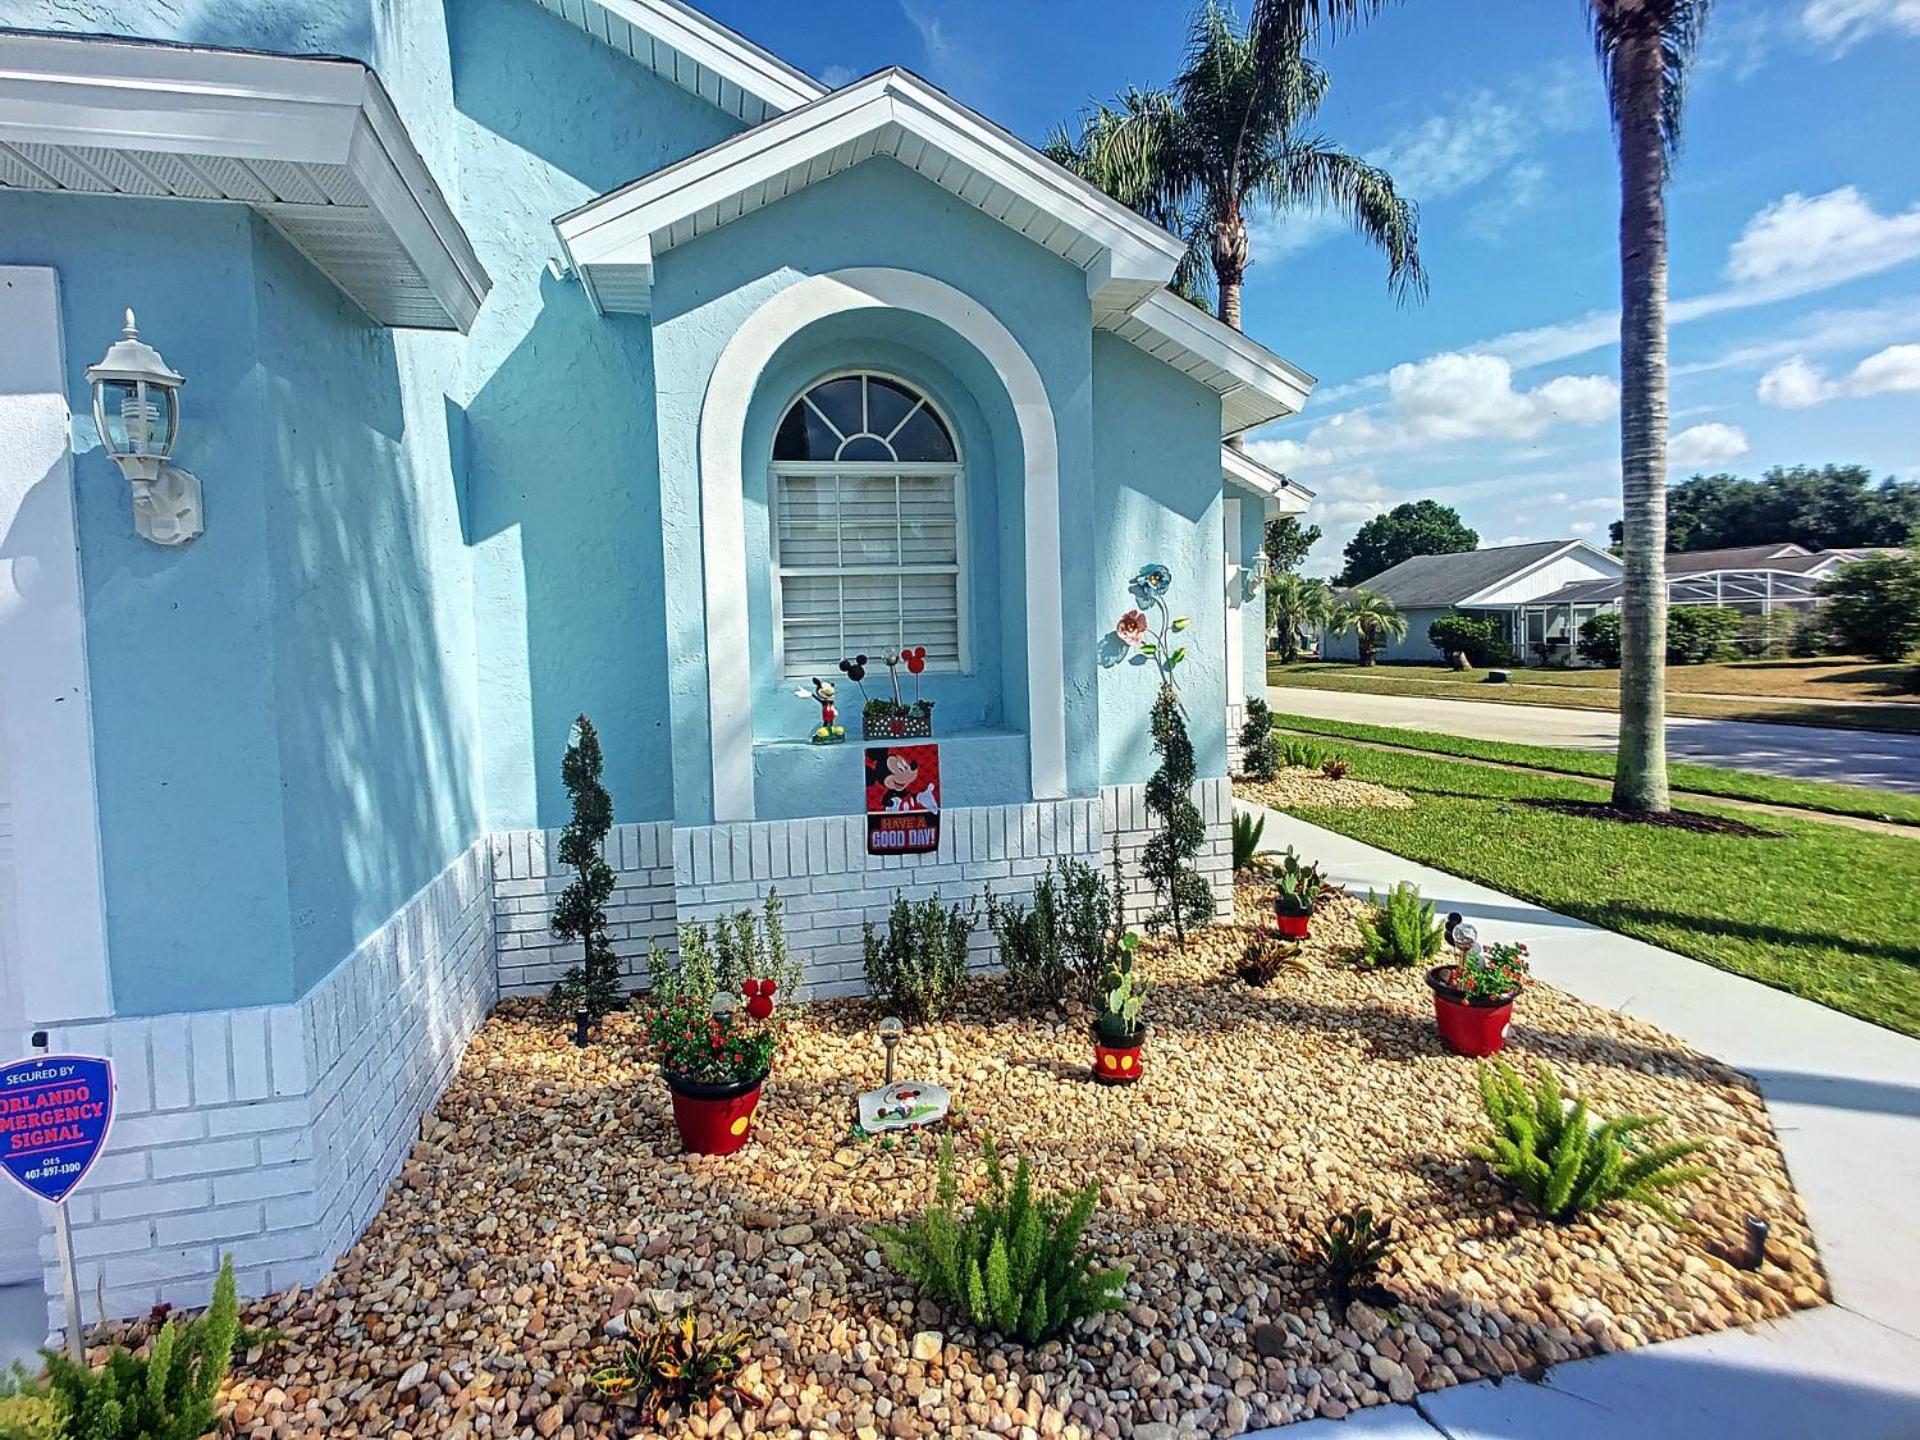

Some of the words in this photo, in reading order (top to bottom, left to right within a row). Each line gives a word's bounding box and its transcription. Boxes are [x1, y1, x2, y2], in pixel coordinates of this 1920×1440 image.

[881, 817, 914, 830] HAVE
[917, 816, 927, 829] A
[872, 830, 905, 847] GOOD
[909, 828, 935, 846] DAY!
[6, 1068, 58, 1085] SECURED
[59, 1065, 75, 1076] BY
[0, 1086, 90, 1115] ORLANDO
[0, 1101, 103, 1133] MERGENCY
[10, 1124, 84, 1150] SIGNAL
